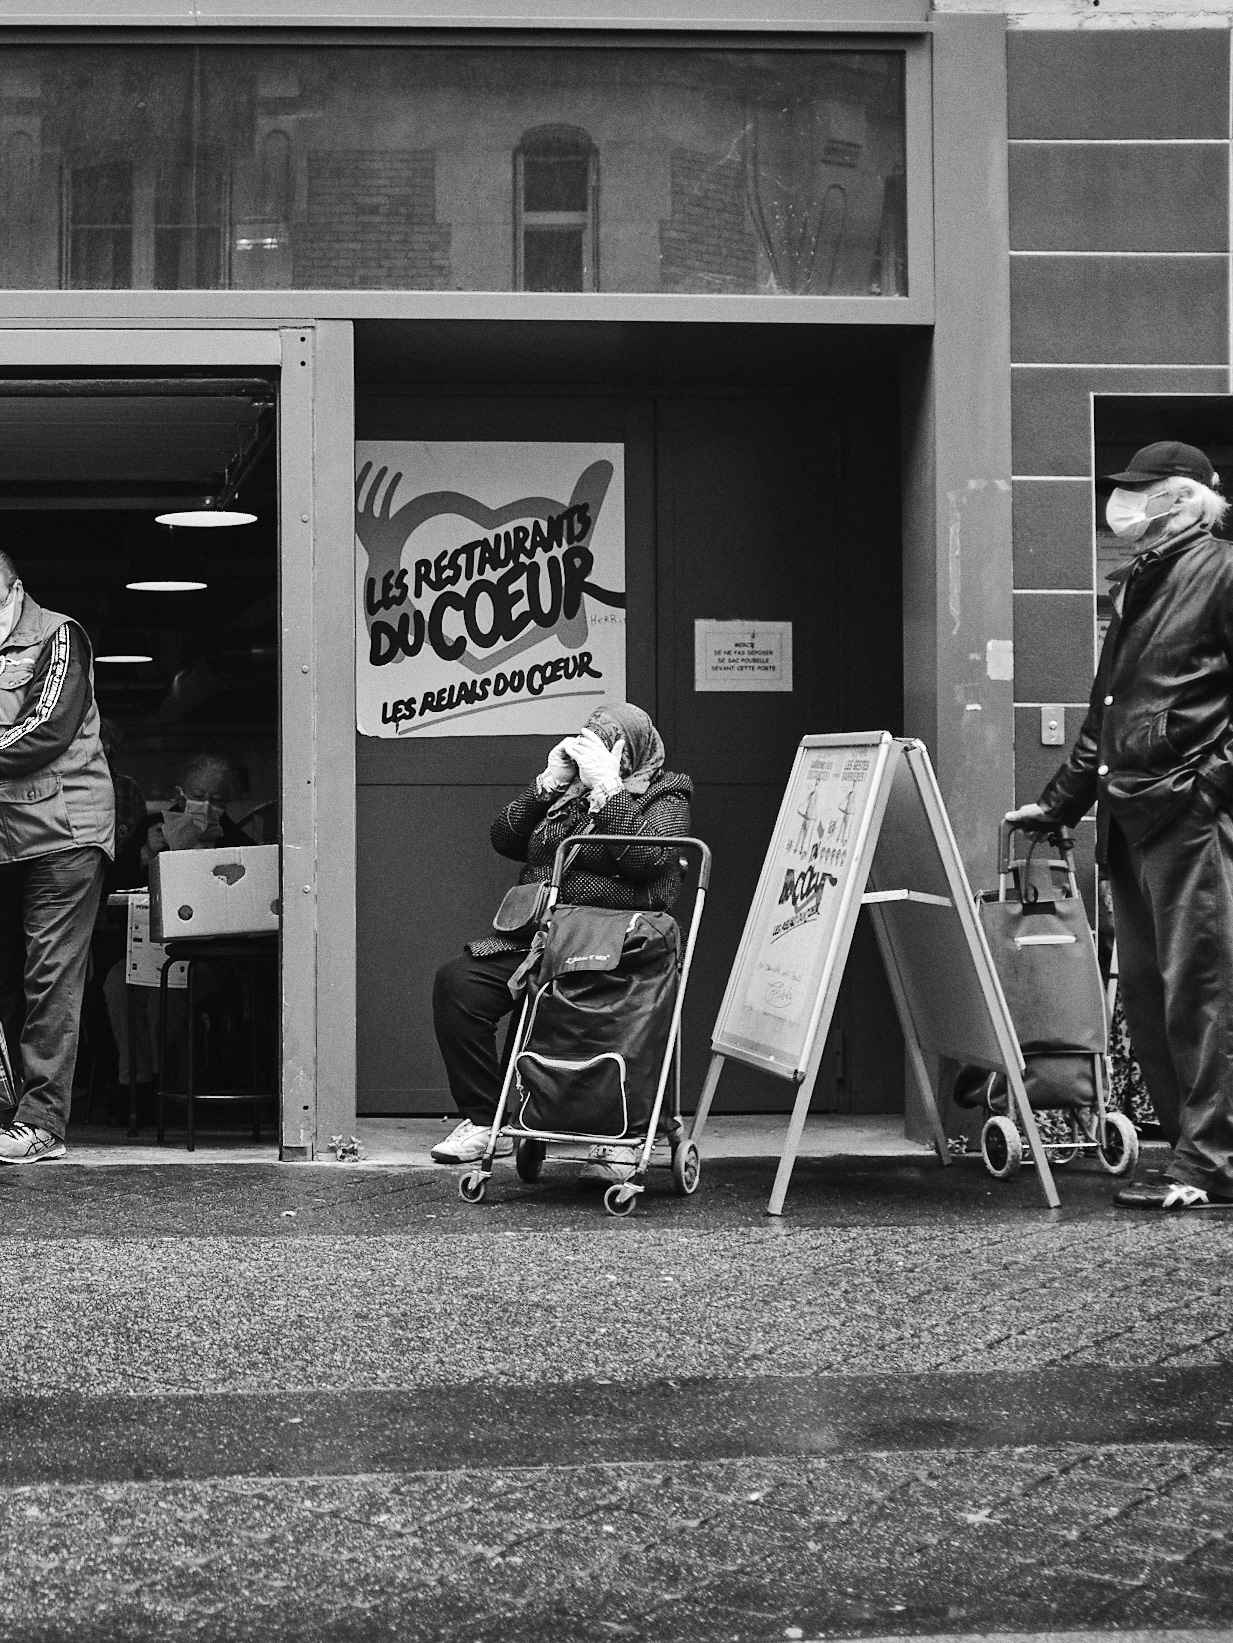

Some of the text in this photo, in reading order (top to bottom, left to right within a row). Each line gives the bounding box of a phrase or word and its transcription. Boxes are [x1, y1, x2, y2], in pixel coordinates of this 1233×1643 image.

[367, 502, 591, 617] LES RESTAURANTS
[369, 609, 425, 667] DU
[382, 697, 417, 725] LES
[418, 677, 491, 717] RELAIS
[493, 669, 525, 697] DU
